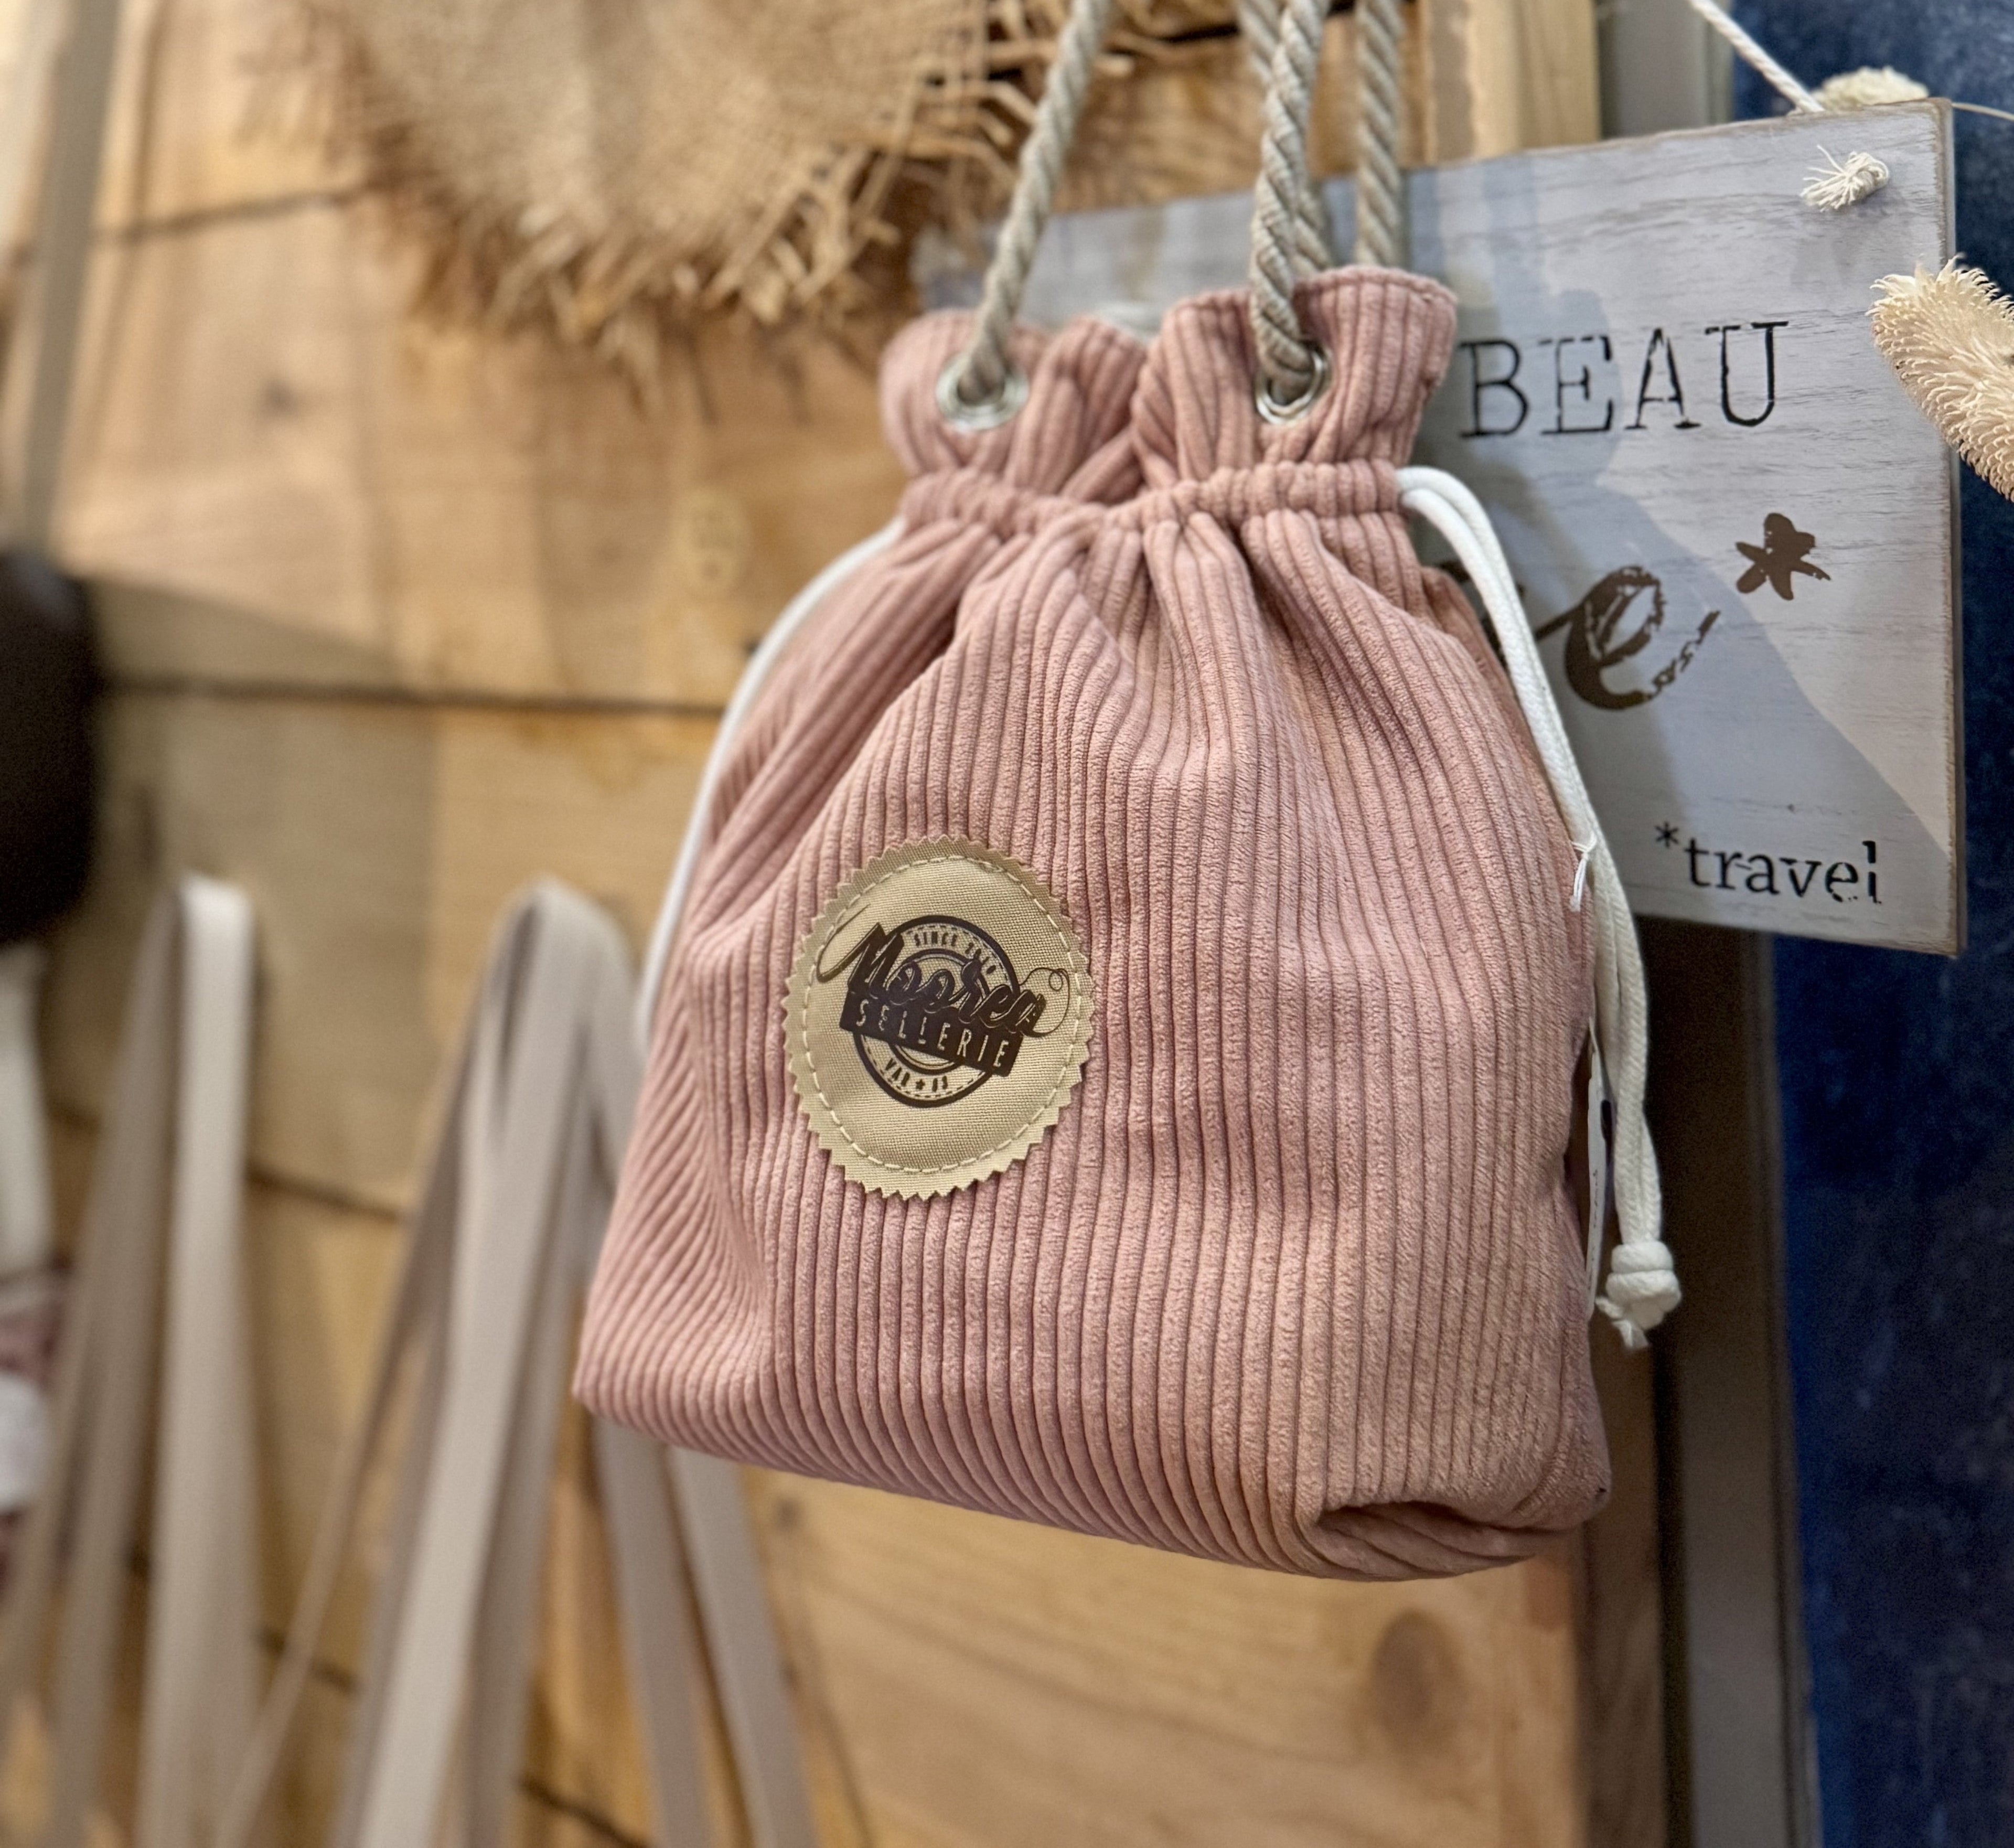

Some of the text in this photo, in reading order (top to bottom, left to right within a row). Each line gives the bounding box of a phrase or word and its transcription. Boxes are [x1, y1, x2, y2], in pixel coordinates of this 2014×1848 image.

[1460, 320, 1789, 439] BEAU
[914, 931, 958, 947] SINCE
[855, 997, 1010, 1069] SELLERIE
